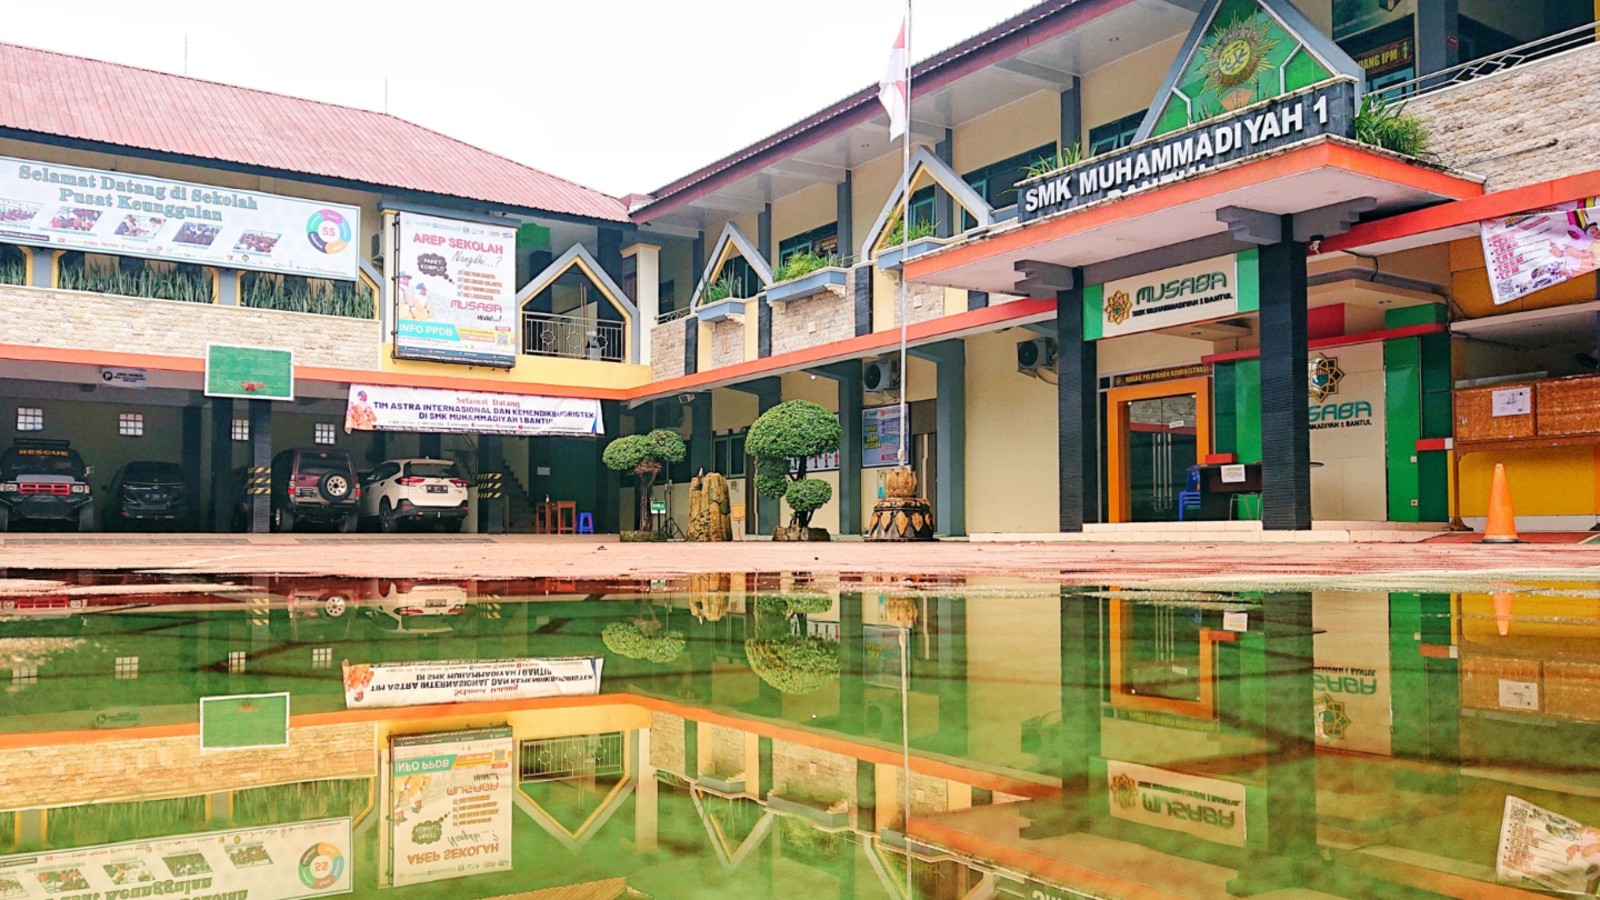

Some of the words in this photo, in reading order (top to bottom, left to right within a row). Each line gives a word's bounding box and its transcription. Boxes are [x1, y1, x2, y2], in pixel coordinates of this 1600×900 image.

[1358, 54, 1380, 70] UANG
[1382, 48, 1398, 64] IPM
[1024, 175, 1072, 213] SMK
[1079, 103, 1304, 196] MUHAMMADIYAH
[1313, 95, 1328, 124] 1
[18, 165, 96, 188] Selamat
[100, 176, 166, 200] Datang
[170, 186, 187, 201] di
[191, 190, 258, 210] Sekolah
[59, 188, 113, 208] Pusat
[117, 194, 222, 221] Keunggulan
[322, 226, 336, 236] 5S
[413, 233, 446, 246] AREP
[448, 238, 503, 254] SEKOLAH
[420, 264, 444, 272] KOMPLIT
[423, 258, 441, 266] PAKET
[1136, 271, 1227, 305] MUSABA
[1204, 293, 1233, 304] BANTUL
[450, 300, 502, 313] MUSABA
[400, 324, 423, 334] INFO
[426, 326, 453, 336] PPDB
[374, 402, 388, 410] TIM
[390, 402, 422, 411] ASTRA
[423, 404, 492, 414] INTERNASIONAL
[456, 396, 488, 405] Selamat
[492, 398, 520, 408] Datang
[1309, 400, 1372, 422] SABA
[418, 412, 428, 420] DI
[430, 412, 448, 420] SMK
[450, 414, 518, 422] MUHAMMADIYAH
[524, 417, 554, 425] BANTU
[1346, 419, 1372, 428] BANTUL
